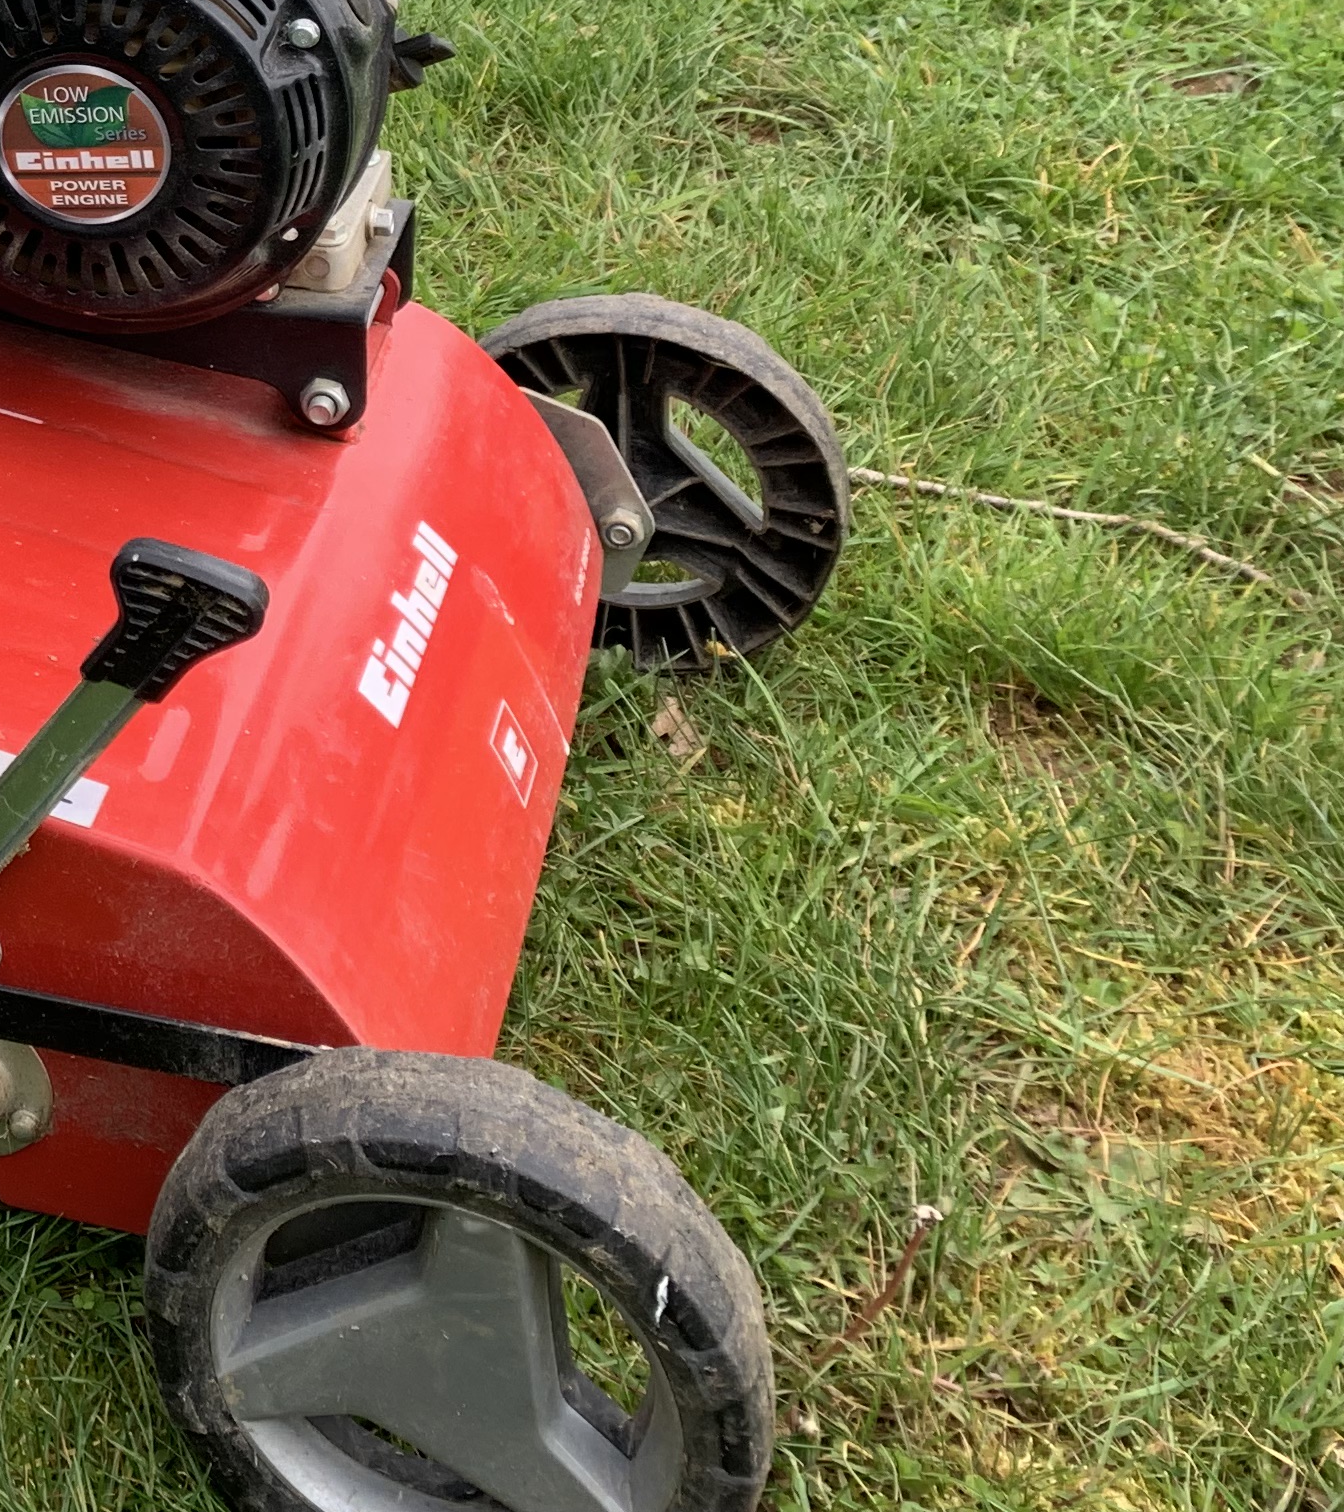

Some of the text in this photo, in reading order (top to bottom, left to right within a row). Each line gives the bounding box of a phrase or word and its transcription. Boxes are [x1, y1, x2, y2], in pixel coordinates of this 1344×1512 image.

[43, 86, 89, 103] LOW
[29, 106, 125, 124] EMISSION
[94, 126, 147, 141] Series
[15, 149, 155, 171] Einhell
[50, 179, 127, 191] POWER
[52, 194, 129, 206] ENGINE
[358, 521, 459, 728] Einhell
